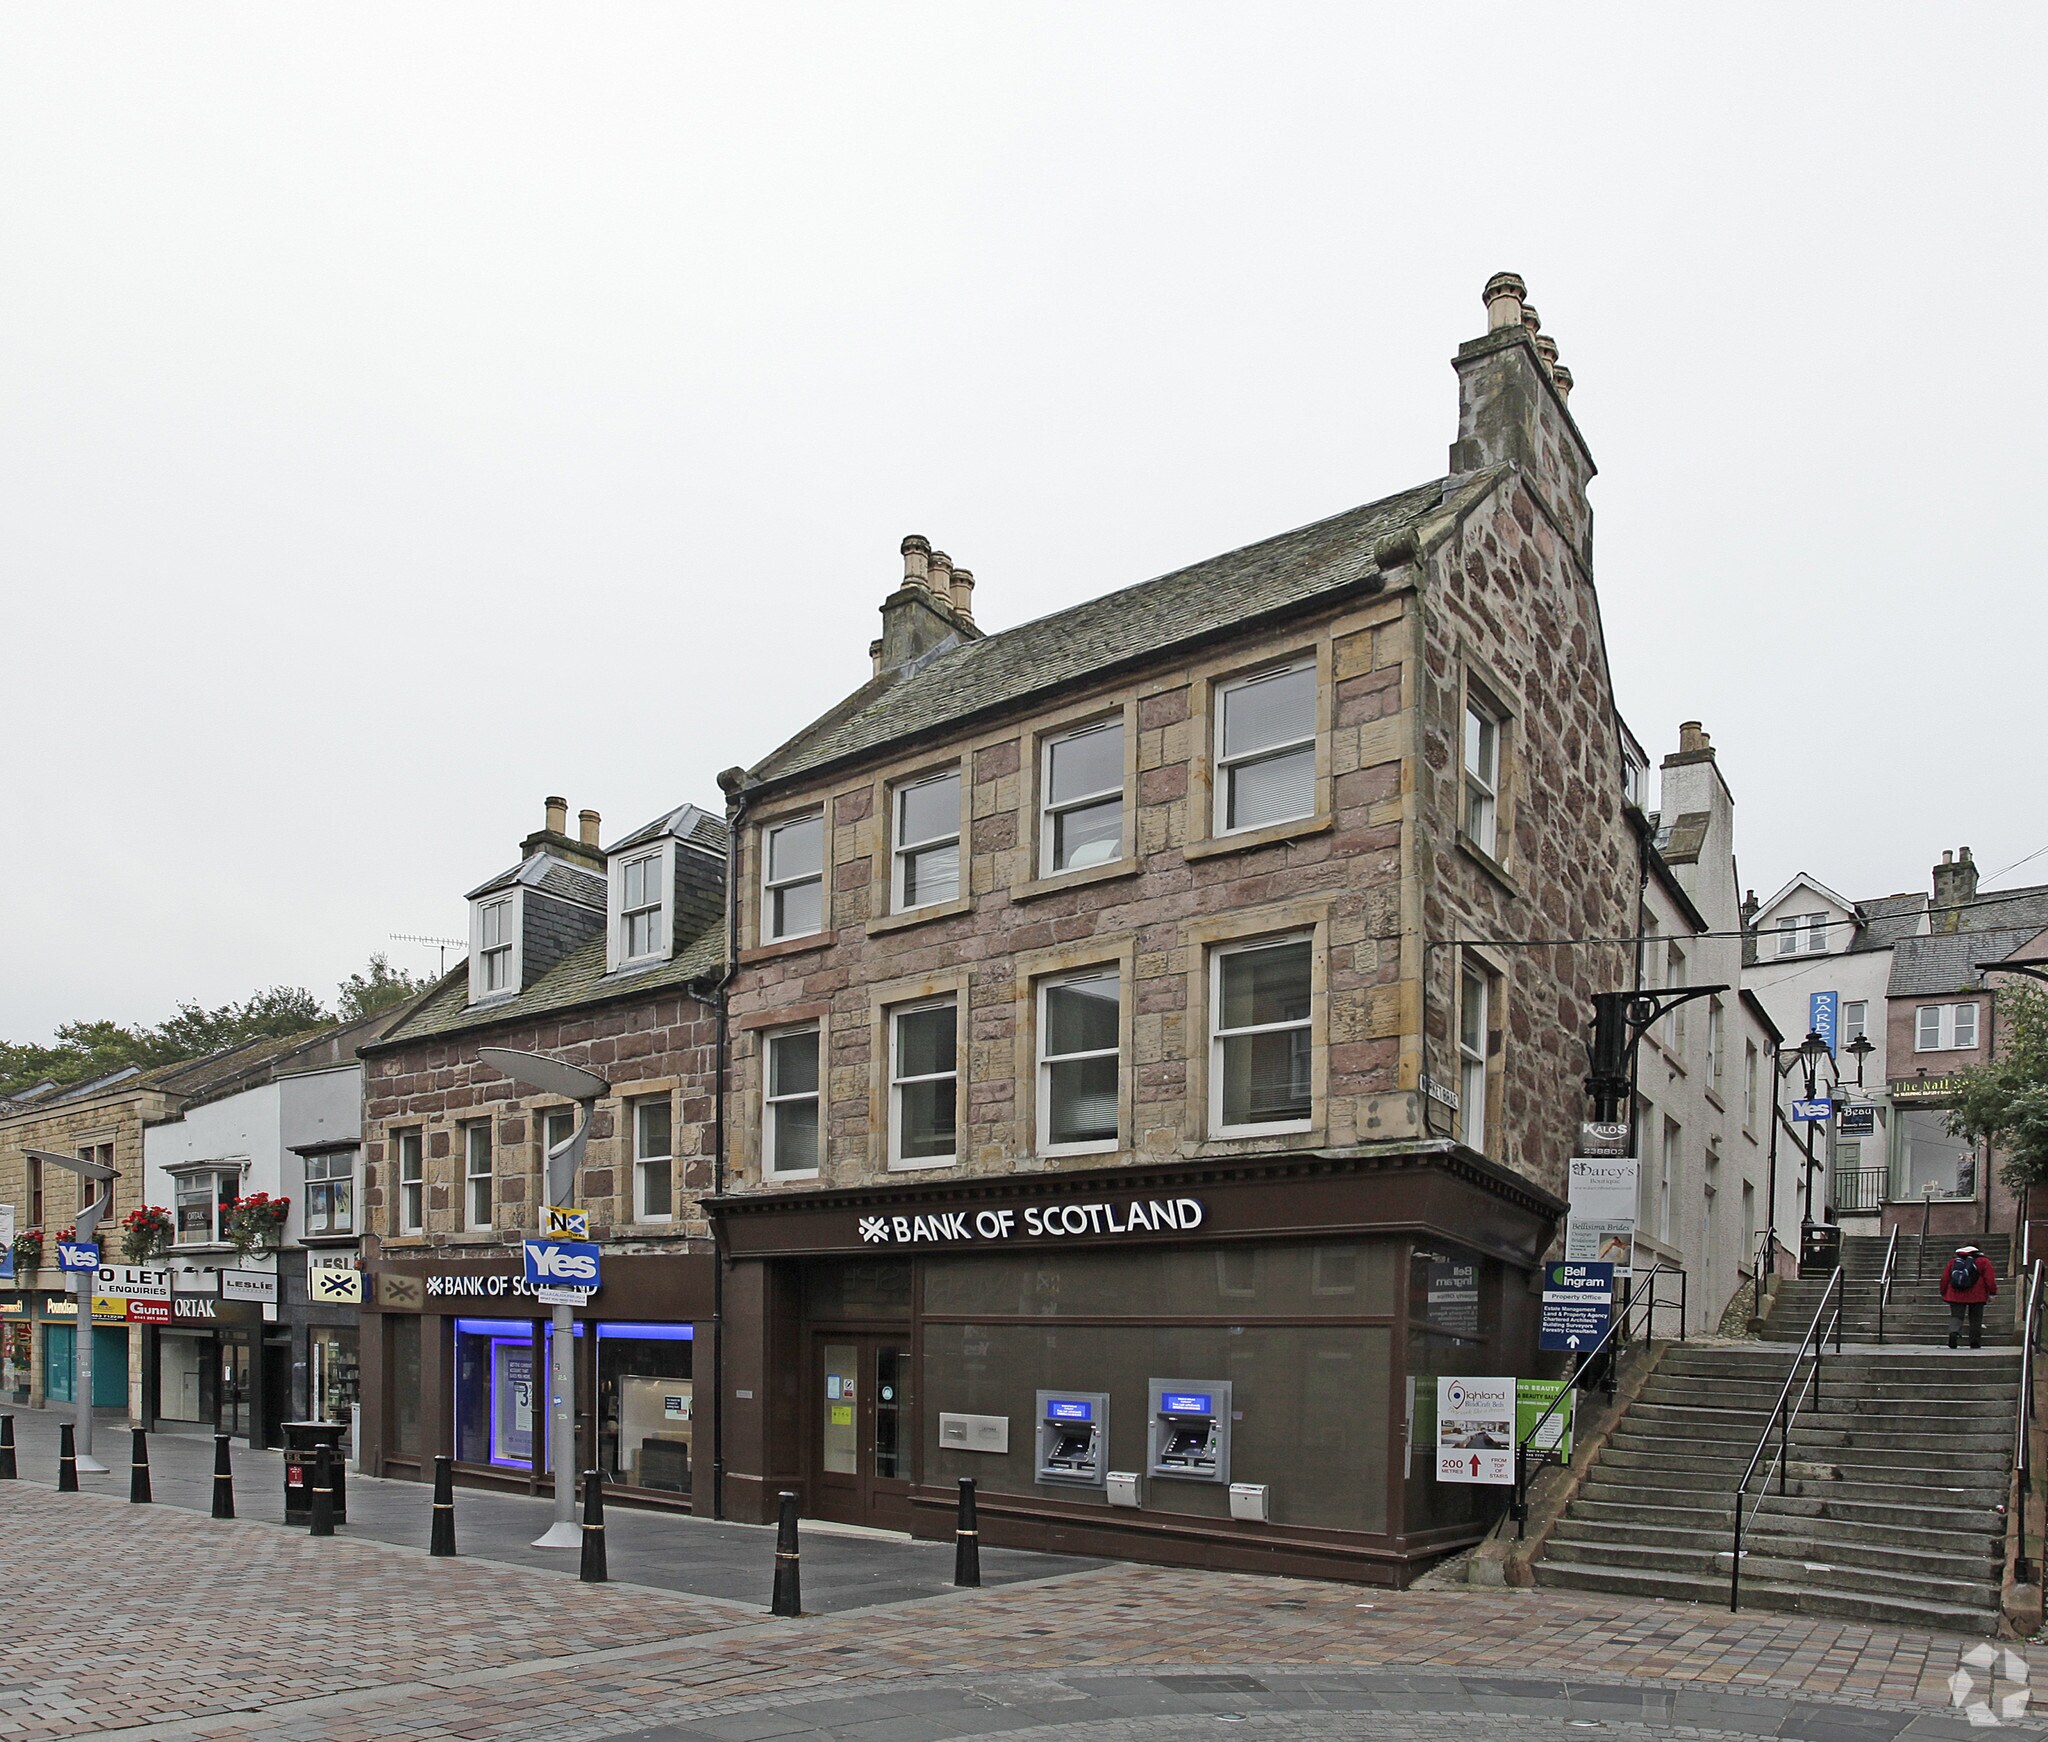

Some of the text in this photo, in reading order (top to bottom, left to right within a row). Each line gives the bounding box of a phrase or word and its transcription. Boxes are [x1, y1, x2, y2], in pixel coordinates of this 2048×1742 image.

[1895, 1081, 1918, 1092] The
[1923, 1078, 1949, 1090] Nail
[1793, 1101, 1830, 1117] Yes
[1843, 1107, 1872, 1117] Beau
[1583, 1123, 1628, 1135] KALOS
[1583, 1147, 1624, 1155] 238802
[187, 1211, 204, 1220] ORTAK
[892, 1197, 1204, 1243] BANK OF SCOTLAND
[1607, 1223, 1630, 1231] Brides
[59, 1245, 98, 1267] Yes
[526, 1244, 597, 1279] Yes
[99, 1268, 167, 1285] O LET
[1564, 1266, 1586, 1276] Bell
[445, 1275, 485, 1296] BANK
[487, 1275, 509, 1296] OF
[1563, 1277, 1604, 1289] Ingram
[109, 1285, 167, 1295] ENQUIRIES
[1551, 1293, 1580, 1301] Property
[130, 1301, 168, 1316] Gunn
[174, 1298, 217, 1318] ORTAK
[1442, 1459, 1464, 1468] 200
